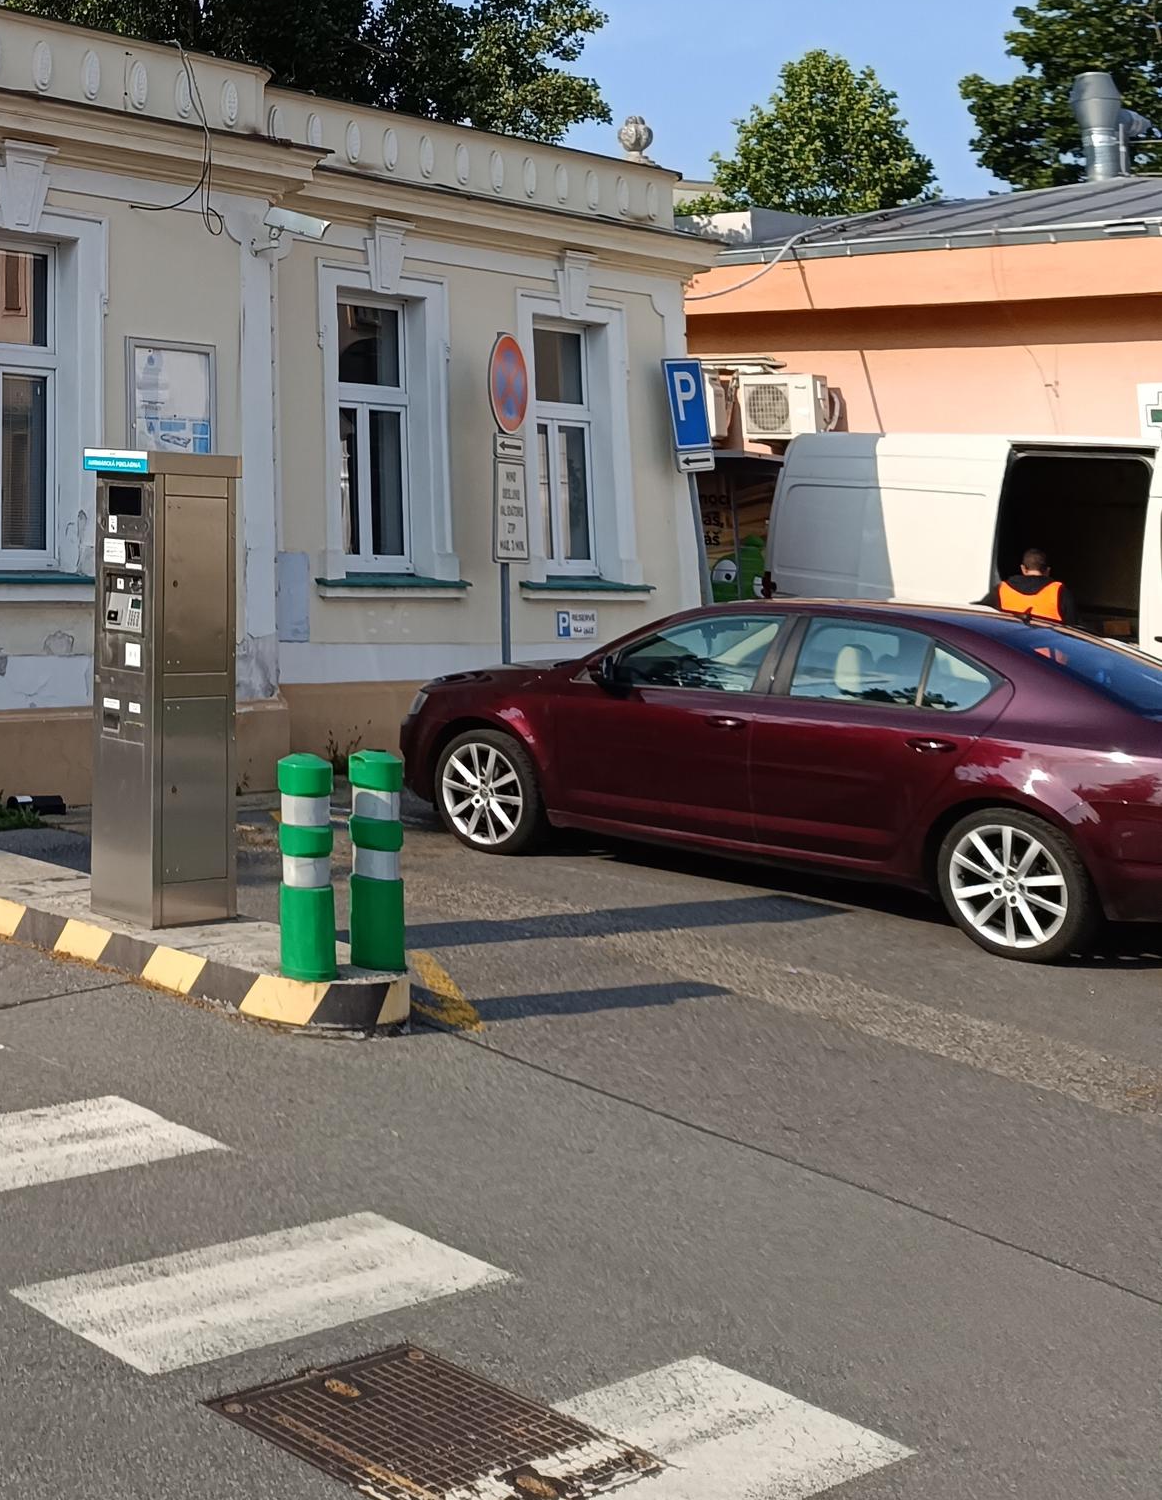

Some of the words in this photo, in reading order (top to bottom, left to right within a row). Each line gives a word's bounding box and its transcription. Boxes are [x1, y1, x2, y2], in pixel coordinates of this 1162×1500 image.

[673, 371, 697, 421] P
[704, 530, 720, 546] áš
[559, 613, 569, 635] P
